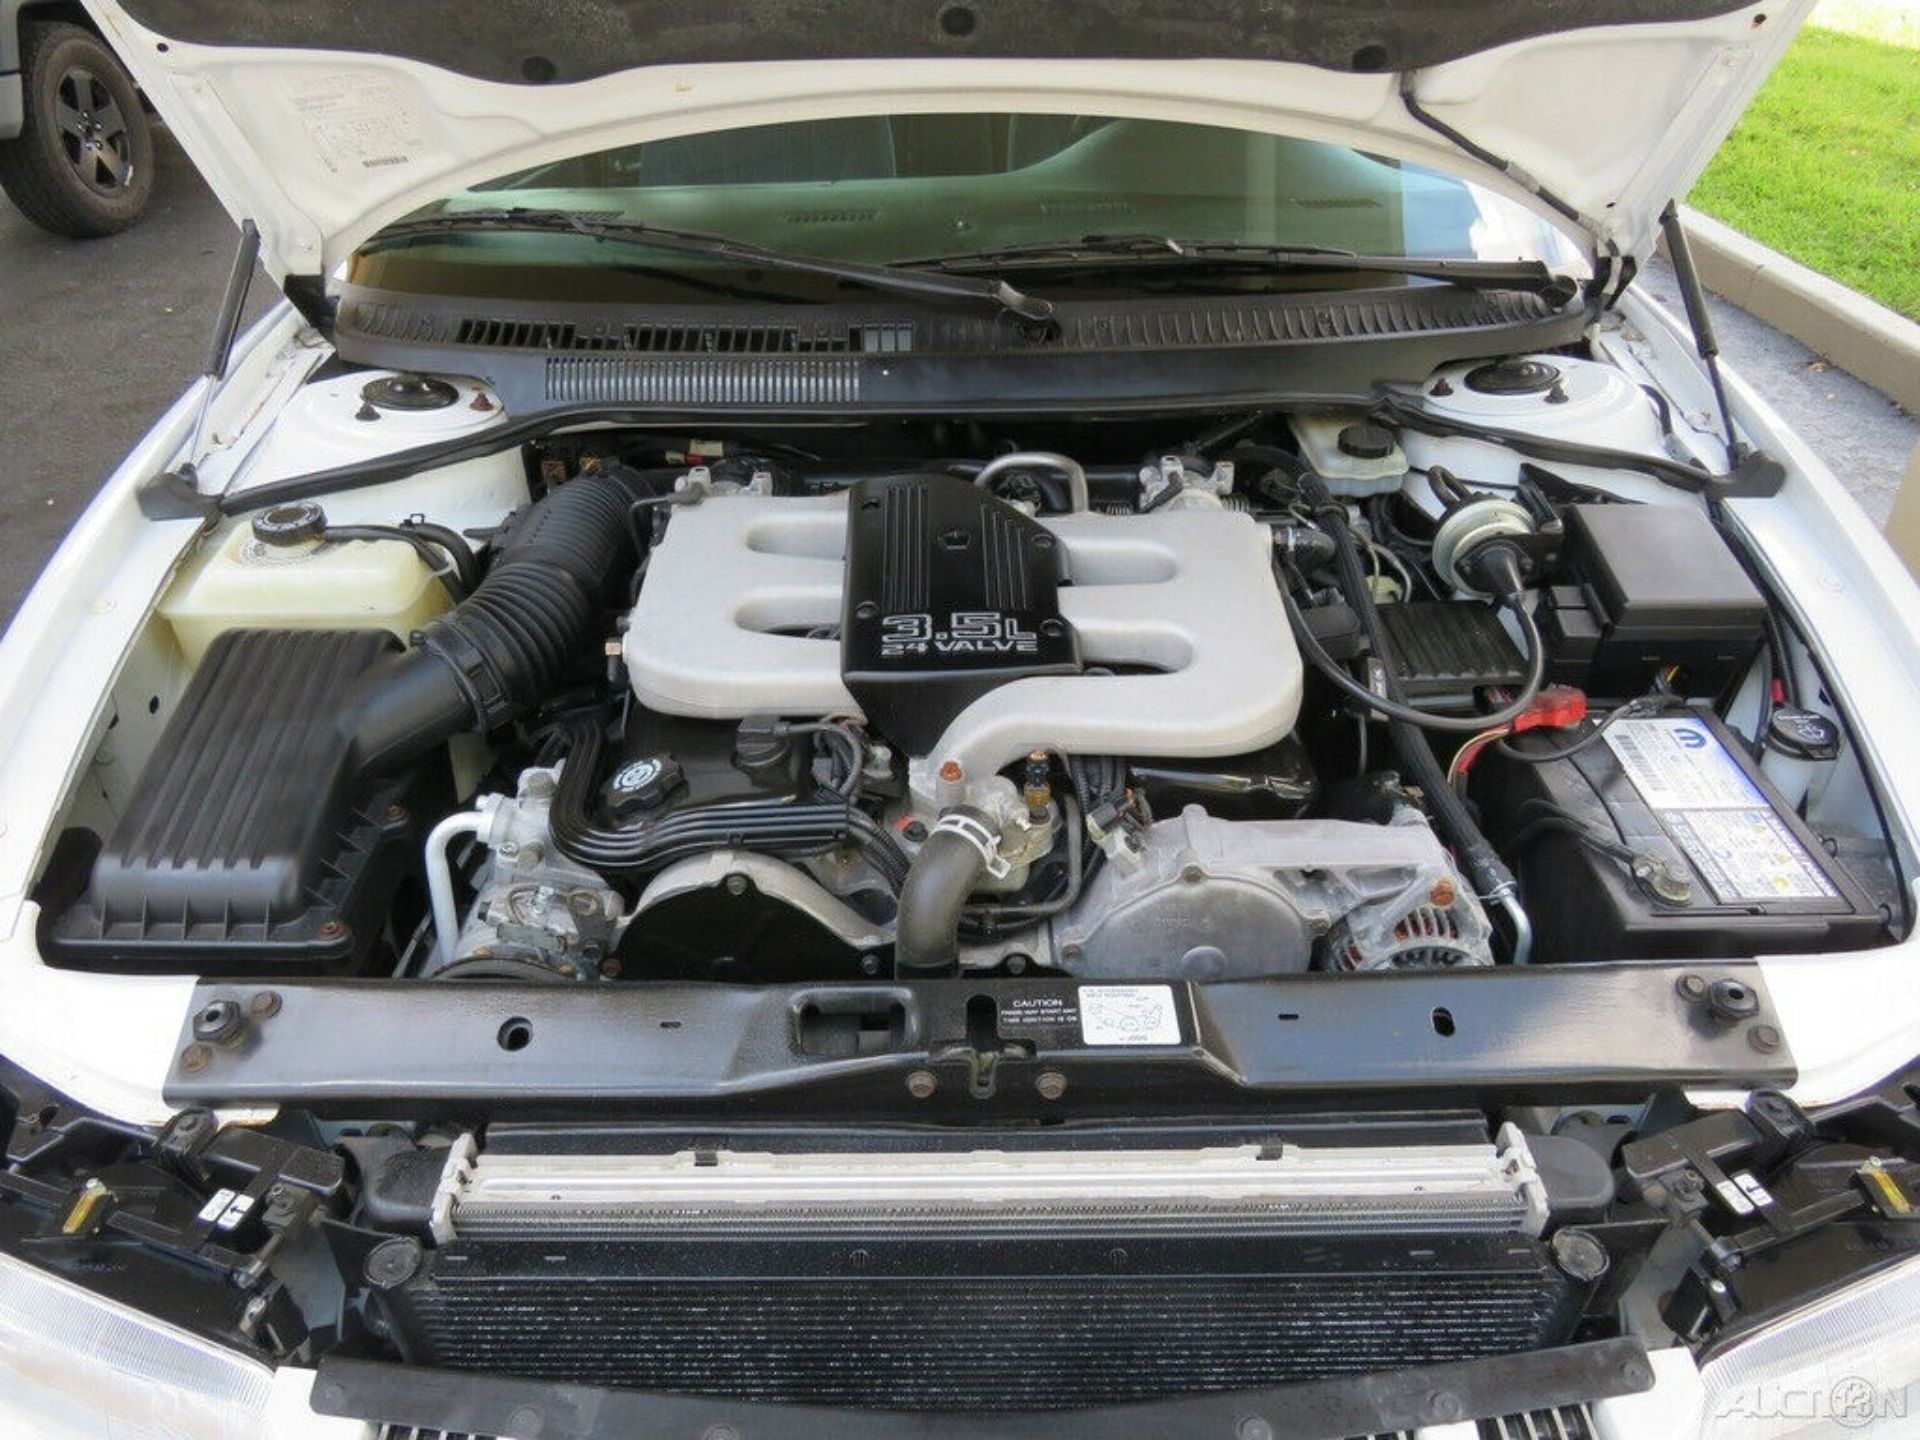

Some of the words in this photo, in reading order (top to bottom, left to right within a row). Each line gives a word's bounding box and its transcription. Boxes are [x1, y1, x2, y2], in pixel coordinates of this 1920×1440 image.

[882, 612, 1037, 643] 3.5L
[881, 641, 928, 656] 24
[933, 640, 1038, 652] VALVE
[1012, 998, 1063, 1008] CAUTION
